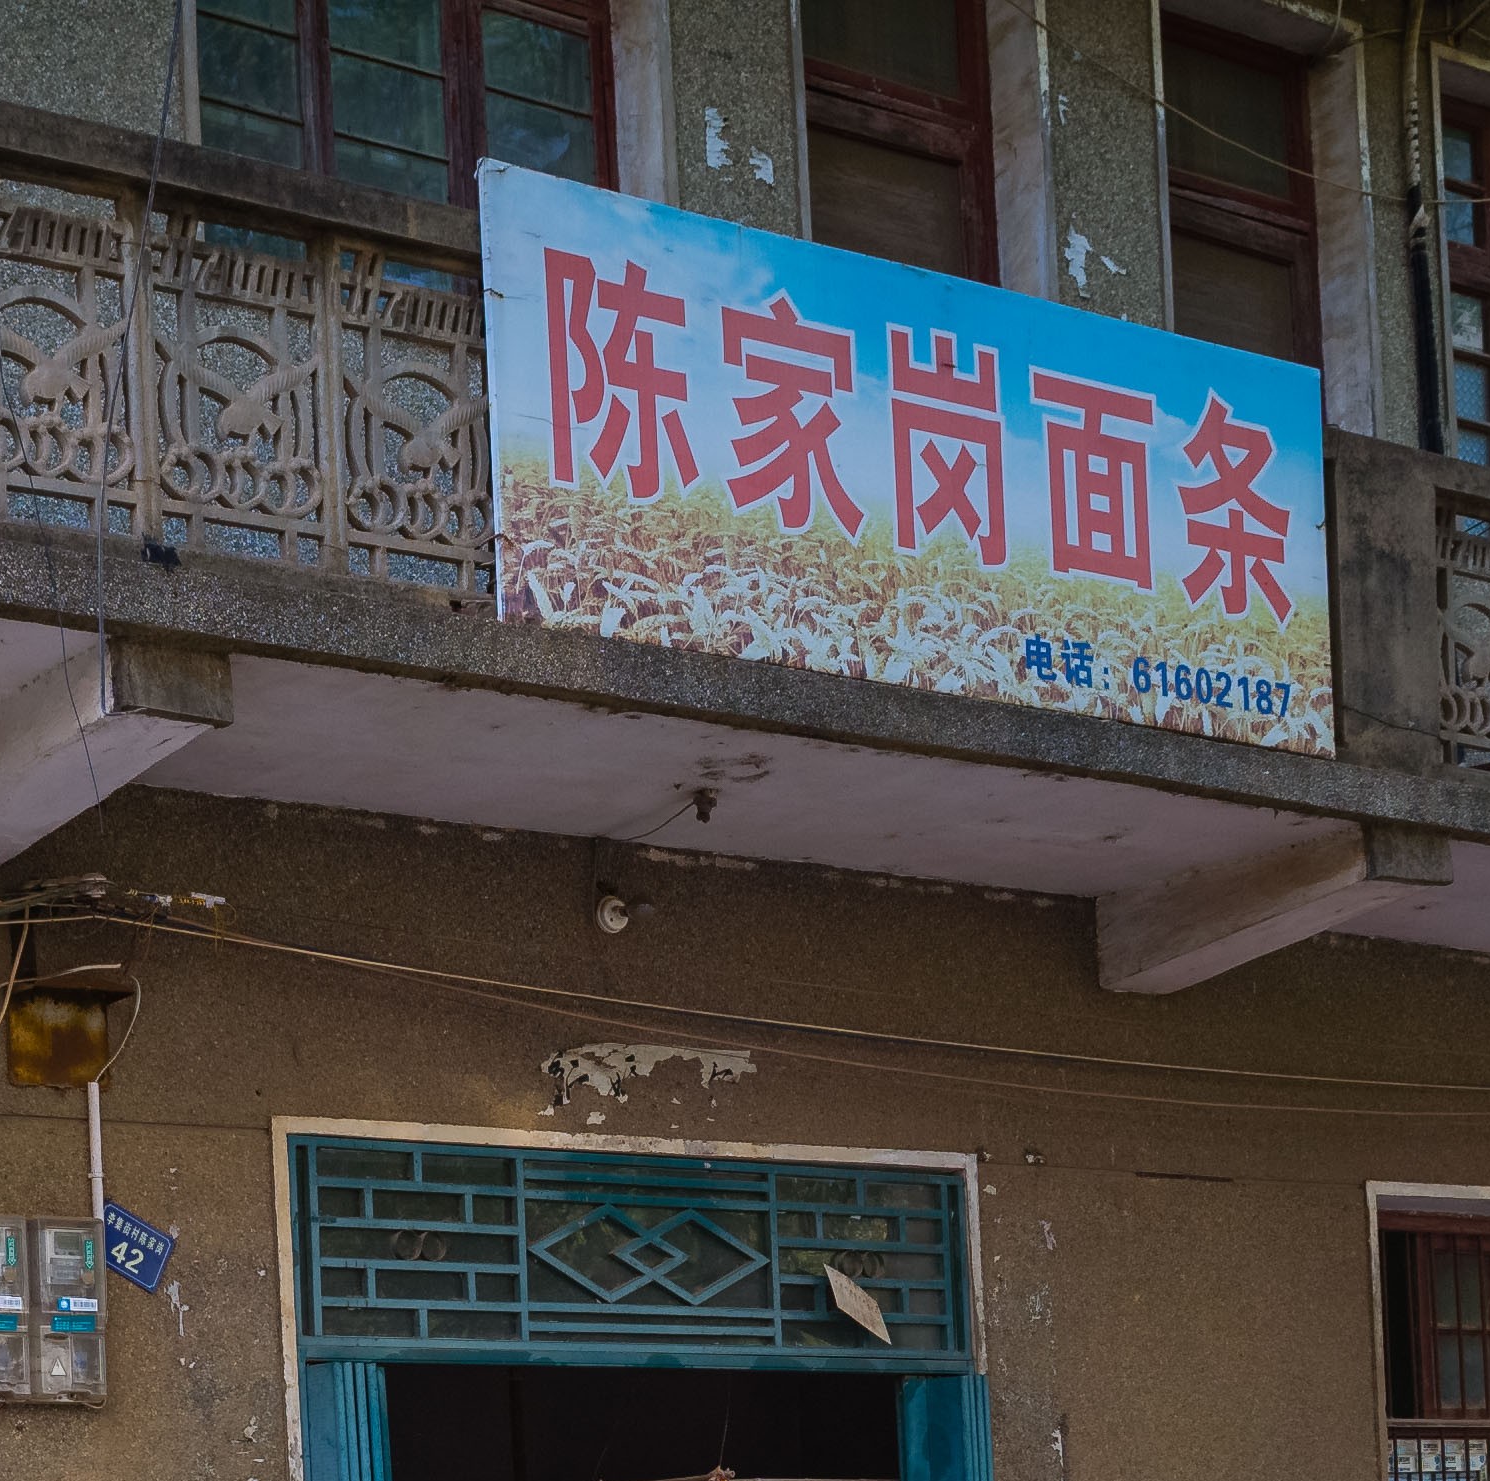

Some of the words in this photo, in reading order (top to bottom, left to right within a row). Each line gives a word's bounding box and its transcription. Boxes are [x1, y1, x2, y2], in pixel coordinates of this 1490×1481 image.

[543, 246, 1293, 630] 陈家岗面条
[1133, 656, 1291, 718] 61602187
[111, 1241, 144, 1274] 42
